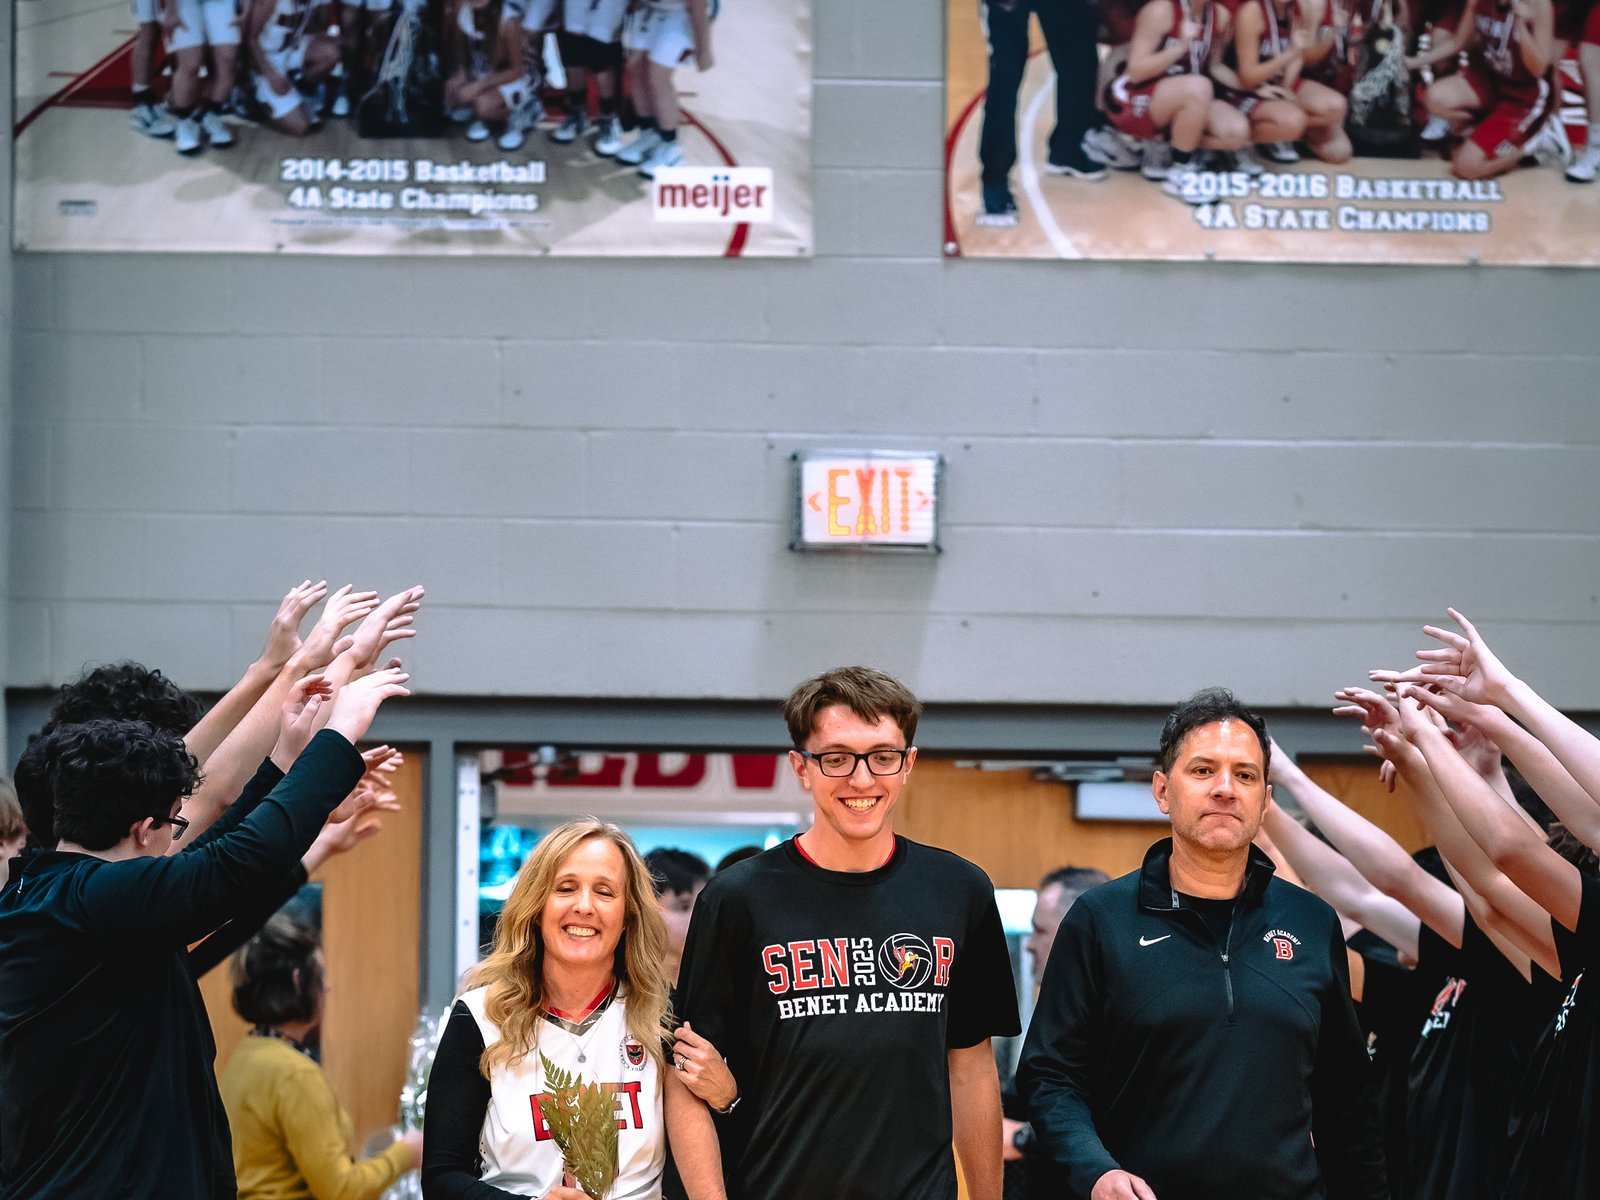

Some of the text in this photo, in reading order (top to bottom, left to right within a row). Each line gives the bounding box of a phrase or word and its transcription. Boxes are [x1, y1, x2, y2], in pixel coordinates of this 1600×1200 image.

[281, 158, 547, 184] 2014-2015 Basketball
[659, 174, 768, 217] meijer
[1181, 172, 1329, 199] 2015-2016
[289, 186, 539, 215] 4A State Champions
[1195, 204, 1237, 229] 4A
[827, 468, 914, 536] EXIT
[1272, 937, 1294, 960] B
[777, 992, 945, 1020] BENET ACADEMY
